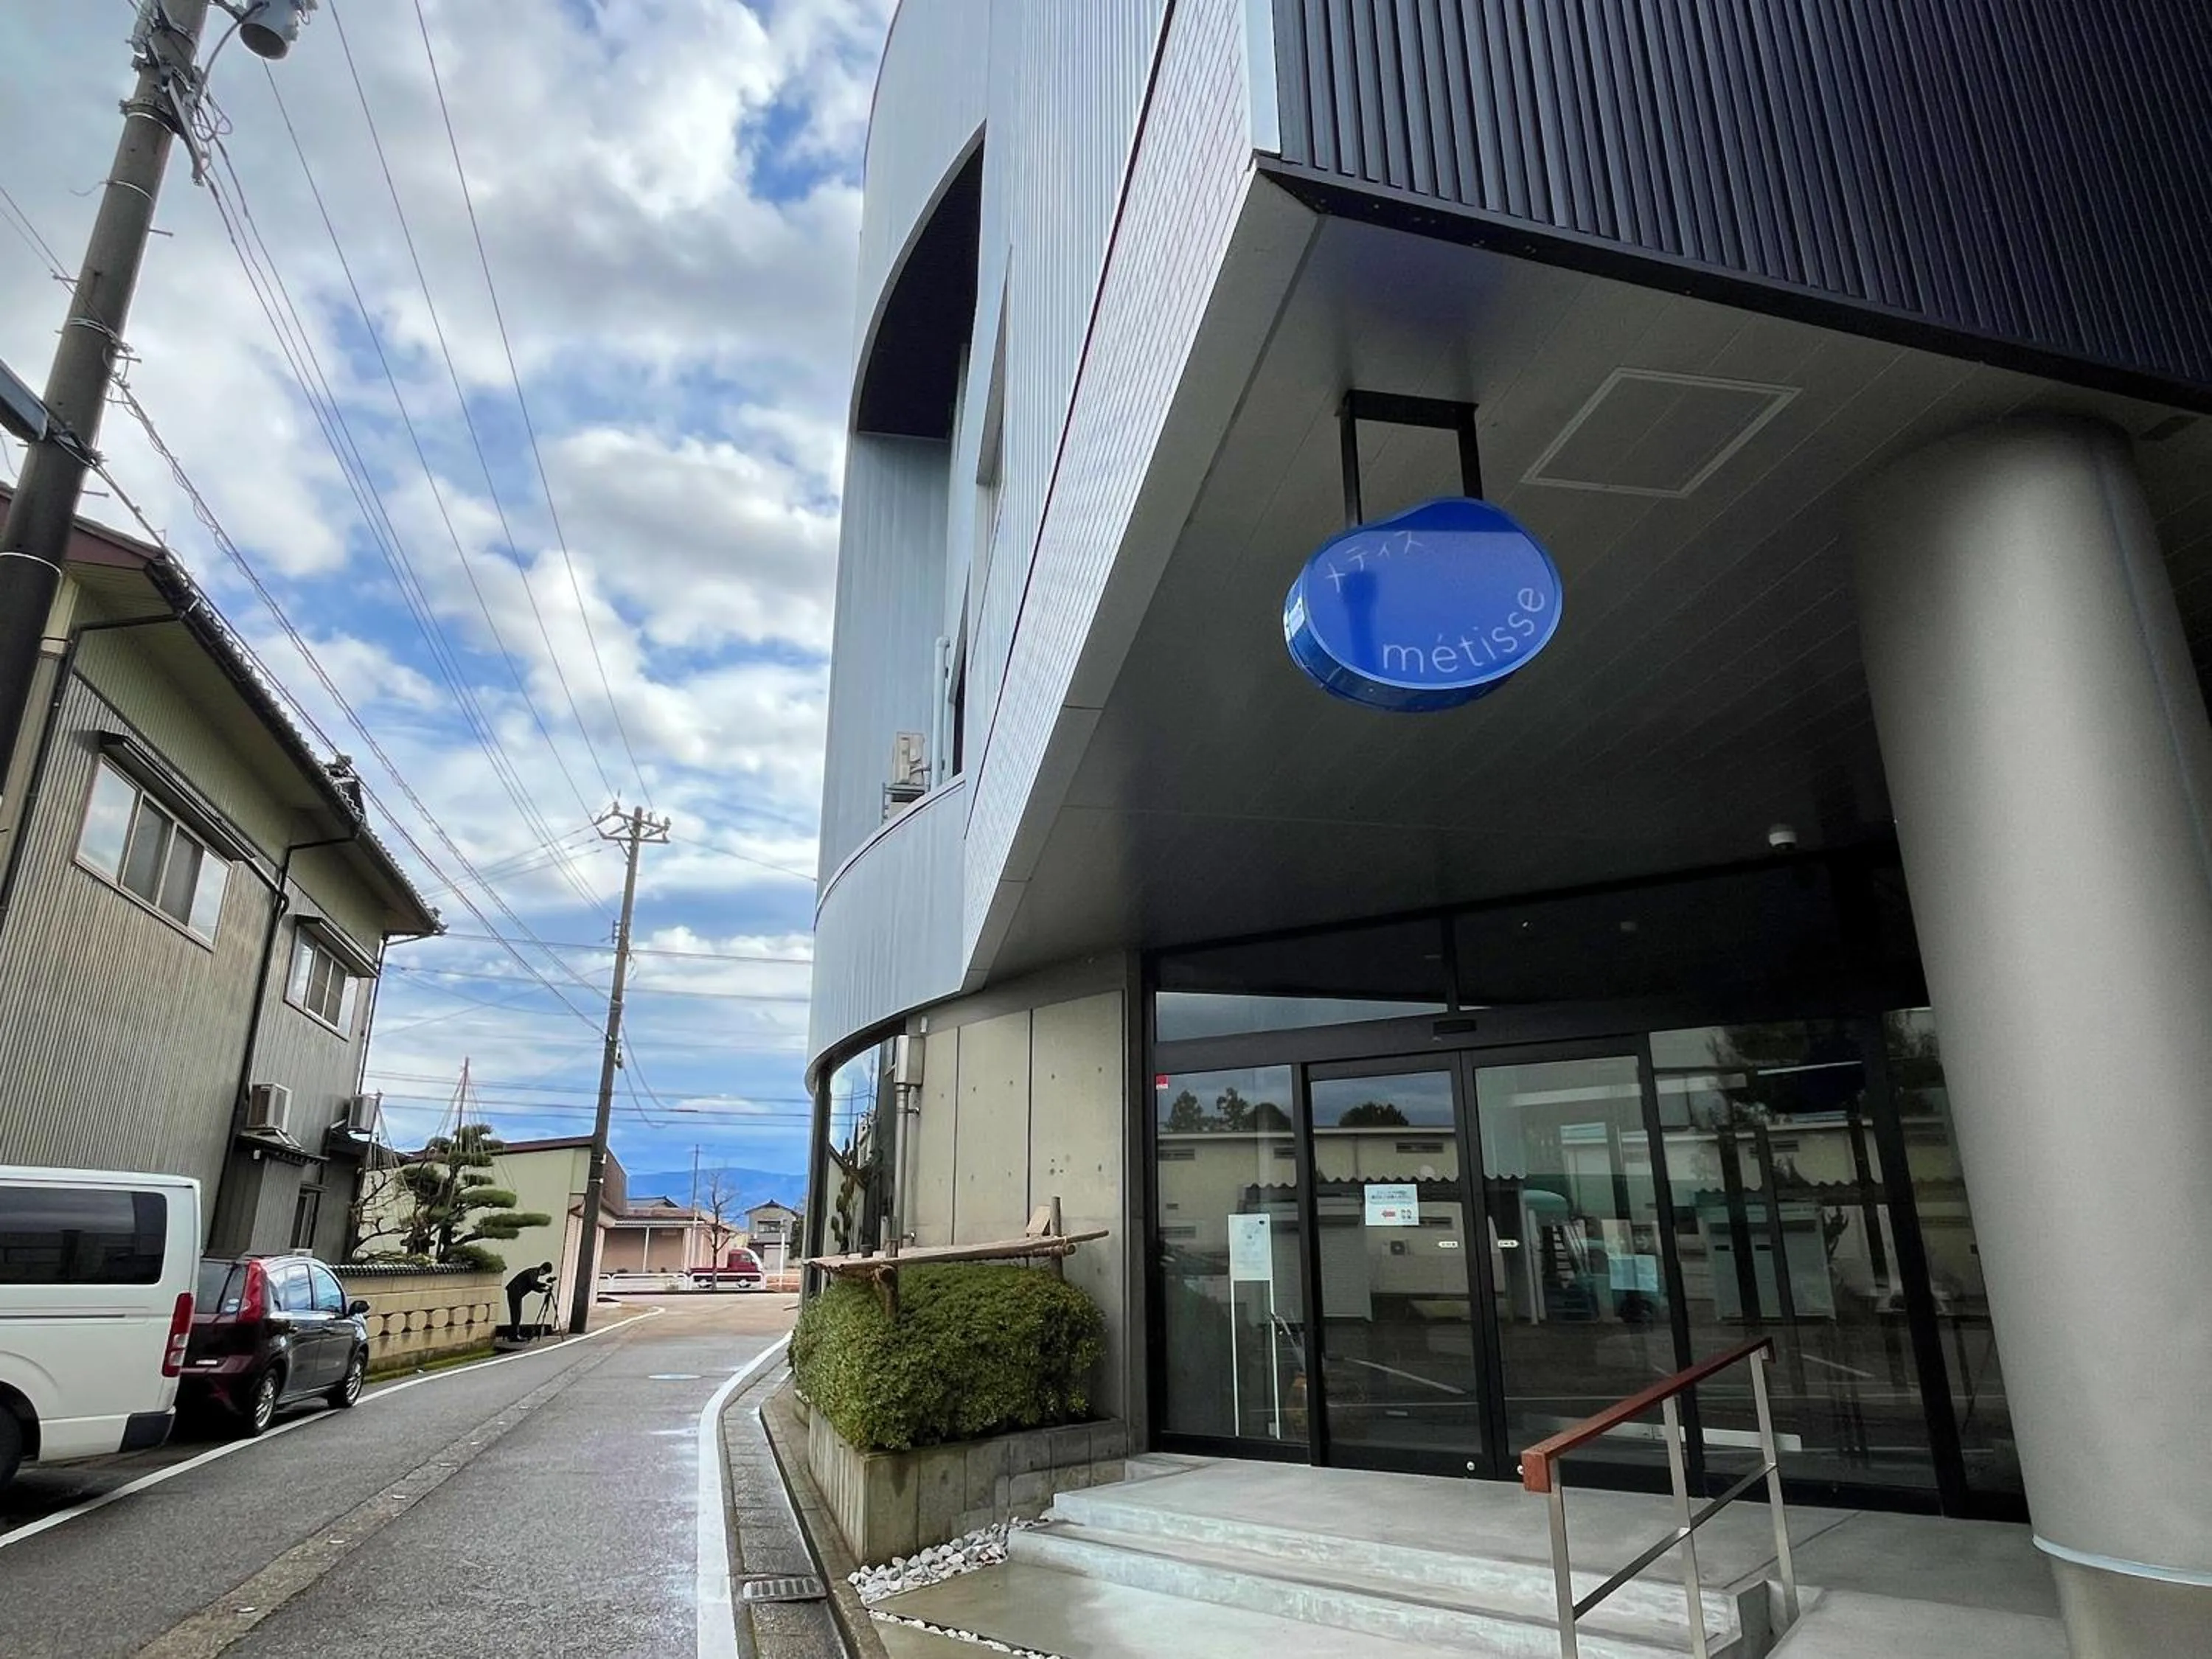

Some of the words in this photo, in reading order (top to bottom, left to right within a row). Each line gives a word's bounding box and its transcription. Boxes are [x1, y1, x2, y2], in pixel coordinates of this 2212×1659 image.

[1325, 530, 1425, 593] メティス
[1382, 587, 1546, 674] métisse
